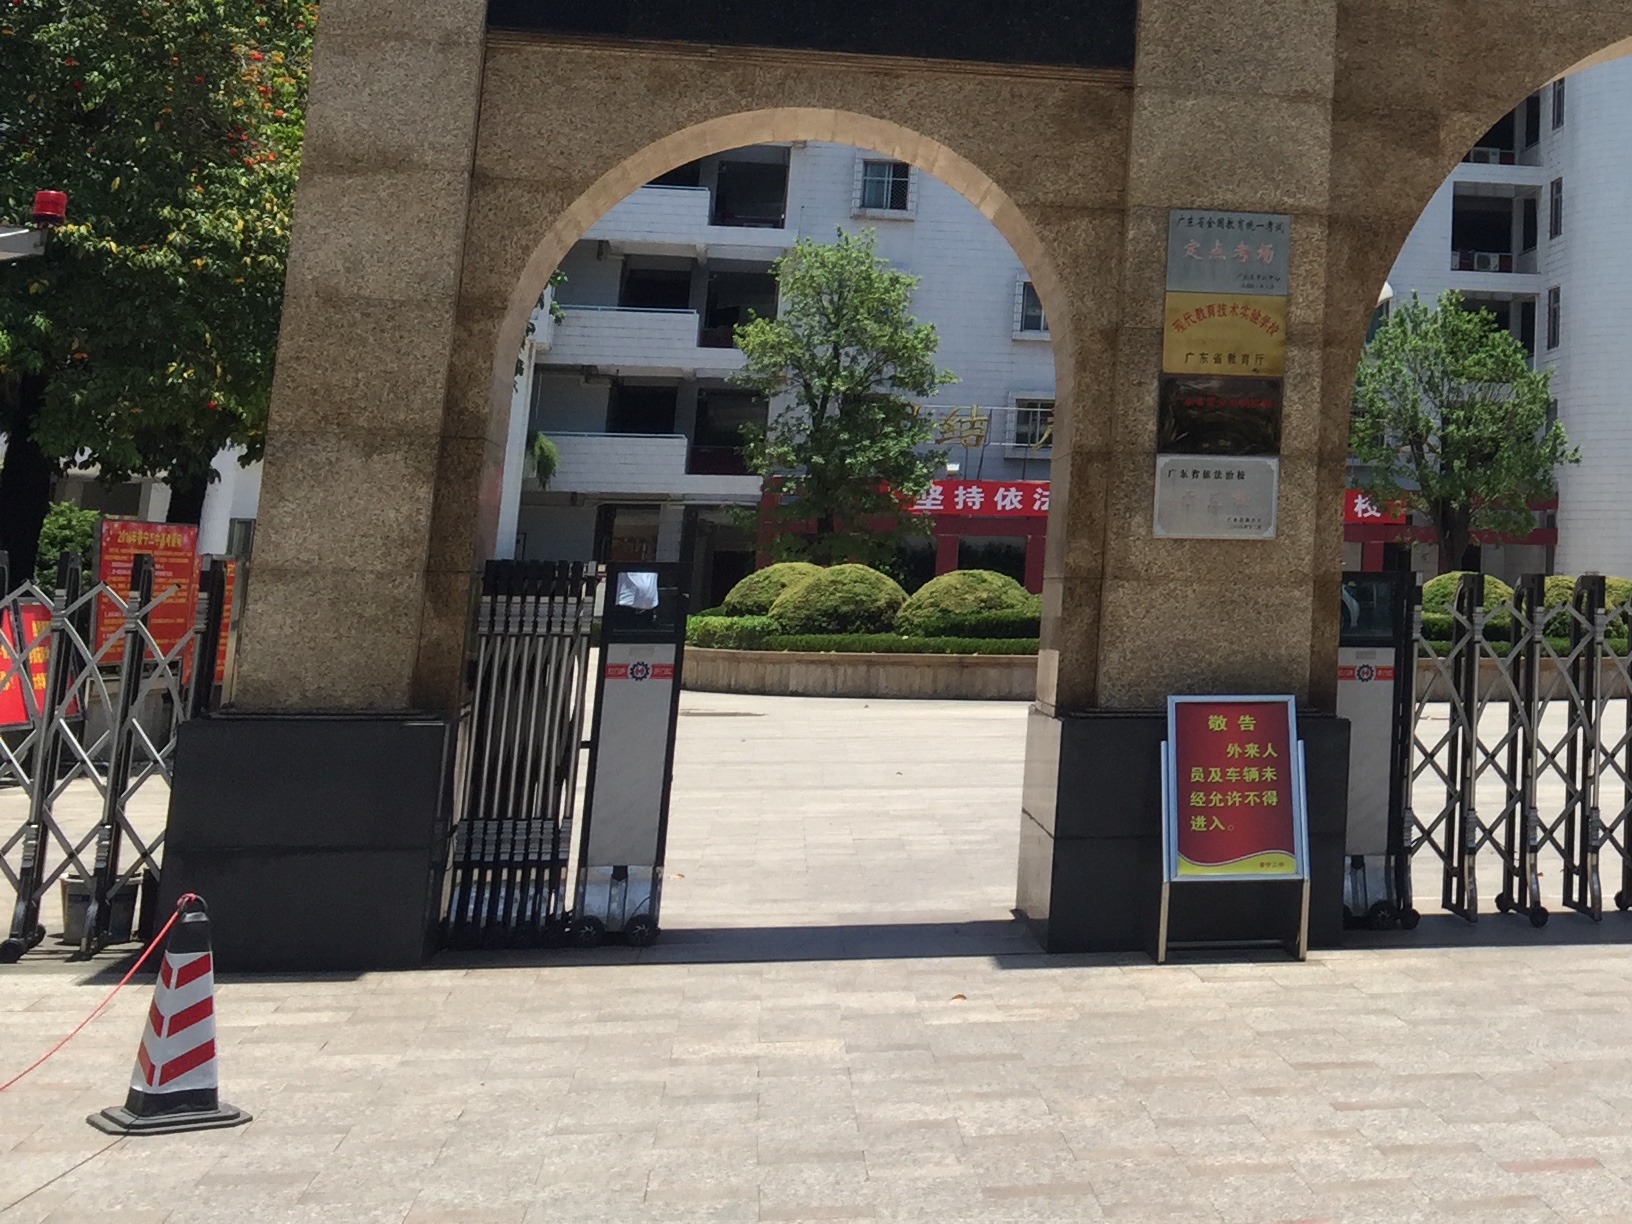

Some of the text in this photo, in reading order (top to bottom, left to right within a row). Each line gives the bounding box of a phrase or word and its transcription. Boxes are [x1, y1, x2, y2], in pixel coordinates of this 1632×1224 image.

[1172, 302, 1280, 336] 现代教育技术实验学校
[1184, 352, 1265, 366] 广东省教育厅
[1208, 714, 1257, 732] 敬告
[1227, 742, 1278, 759] 外来人
[1190, 767, 1278, 783] 员及车辆未
[1190, 791, 1279, 807] 经允许不得
